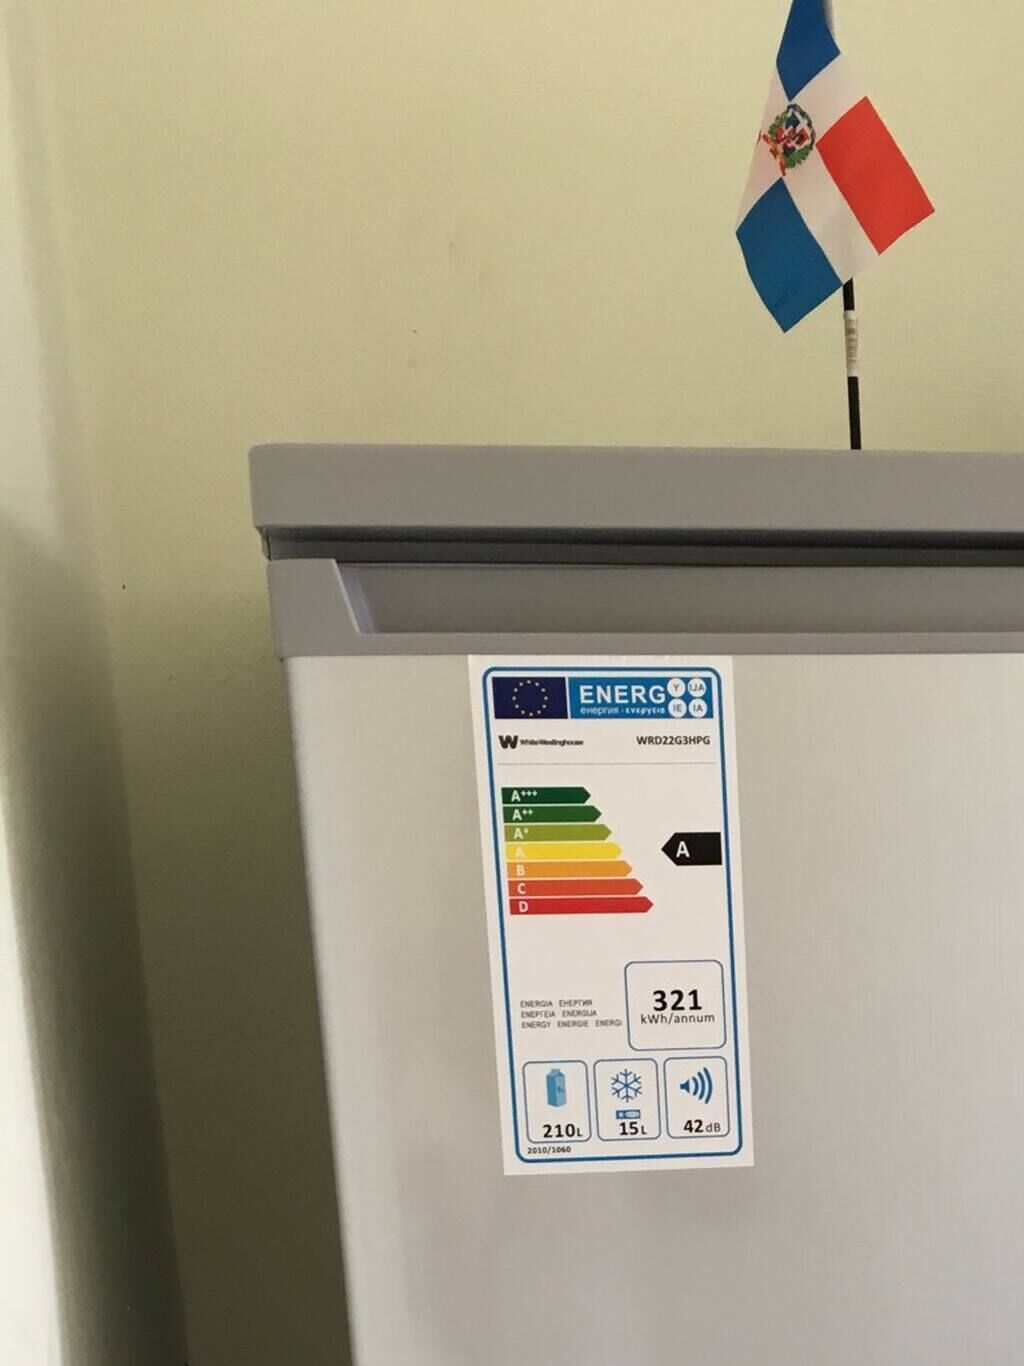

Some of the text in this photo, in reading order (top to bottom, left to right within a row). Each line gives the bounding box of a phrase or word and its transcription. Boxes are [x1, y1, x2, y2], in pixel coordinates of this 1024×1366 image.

[580, 685, 666, 704] ENERG
[672, 683, 680, 692] Y
[498, 735, 519, 749] W
[636, 735, 711, 746] WRD22G3HPG
[511, 790, 538, 802] A+++
[512, 809, 534, 821] A++
[513, 828, 529, 840] A+
[515, 847, 526, 859] A
[675, 840, 690, 858] A
[516, 865, 526, 877] B
[517, 883, 526, 895] C
[518, 901, 529, 913] D
[652, 989, 703, 1012] 321
[641, 1012, 716, 1026] kWh/annum
[527, 1145, 572, 1155] 2010/1060
